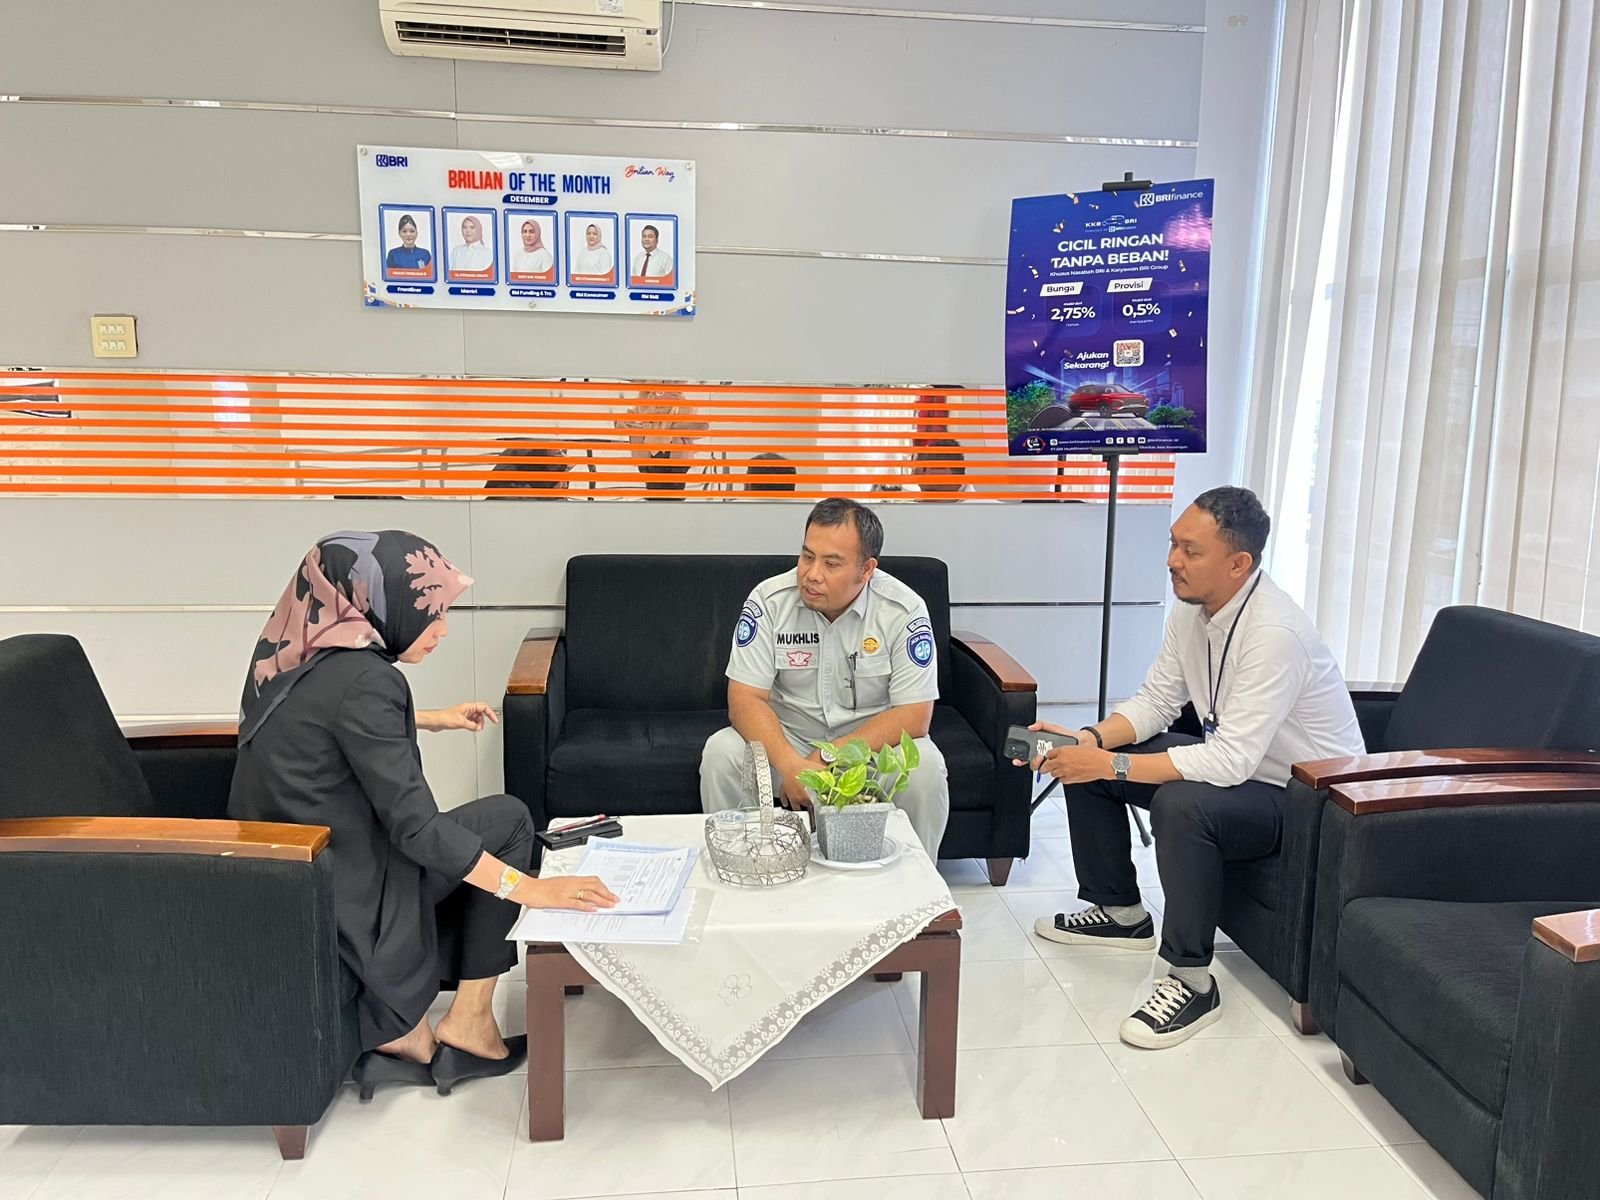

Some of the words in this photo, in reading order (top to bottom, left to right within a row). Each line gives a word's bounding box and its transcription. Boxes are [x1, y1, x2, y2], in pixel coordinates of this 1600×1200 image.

[388, 156, 408, 167] BRI
[655, 167, 675, 182] Way
[448, 169, 503, 190] BRILIAN
[509, 172, 526, 191] OF
[529, 173, 556, 193] THE
[562, 174, 611, 195] MONTH
[510, 195, 550, 204] DESEMBER
[1156, 191, 1204, 203] BRIfinance
[1057, 239, 1097, 252] CICIL
[1100, 233, 1164, 249] RINGAN
[1051, 254, 1104, 269] TANPA
[1107, 250, 1169, 265] BEBAN!
[1110, 266, 1139, 274] Karyawan
[1046, 285, 1075, 293] Bunga
[1114, 280, 1144, 290] Provisi
[1050, 306, 1096, 322] 2,75%
[1122, 303, 1161, 318] 0,5%
[1076, 351, 1109, 361] Ajukan
[1063, 361, 1110, 370] Sekarang!
[776, 632, 820, 645] MUKHLIS
